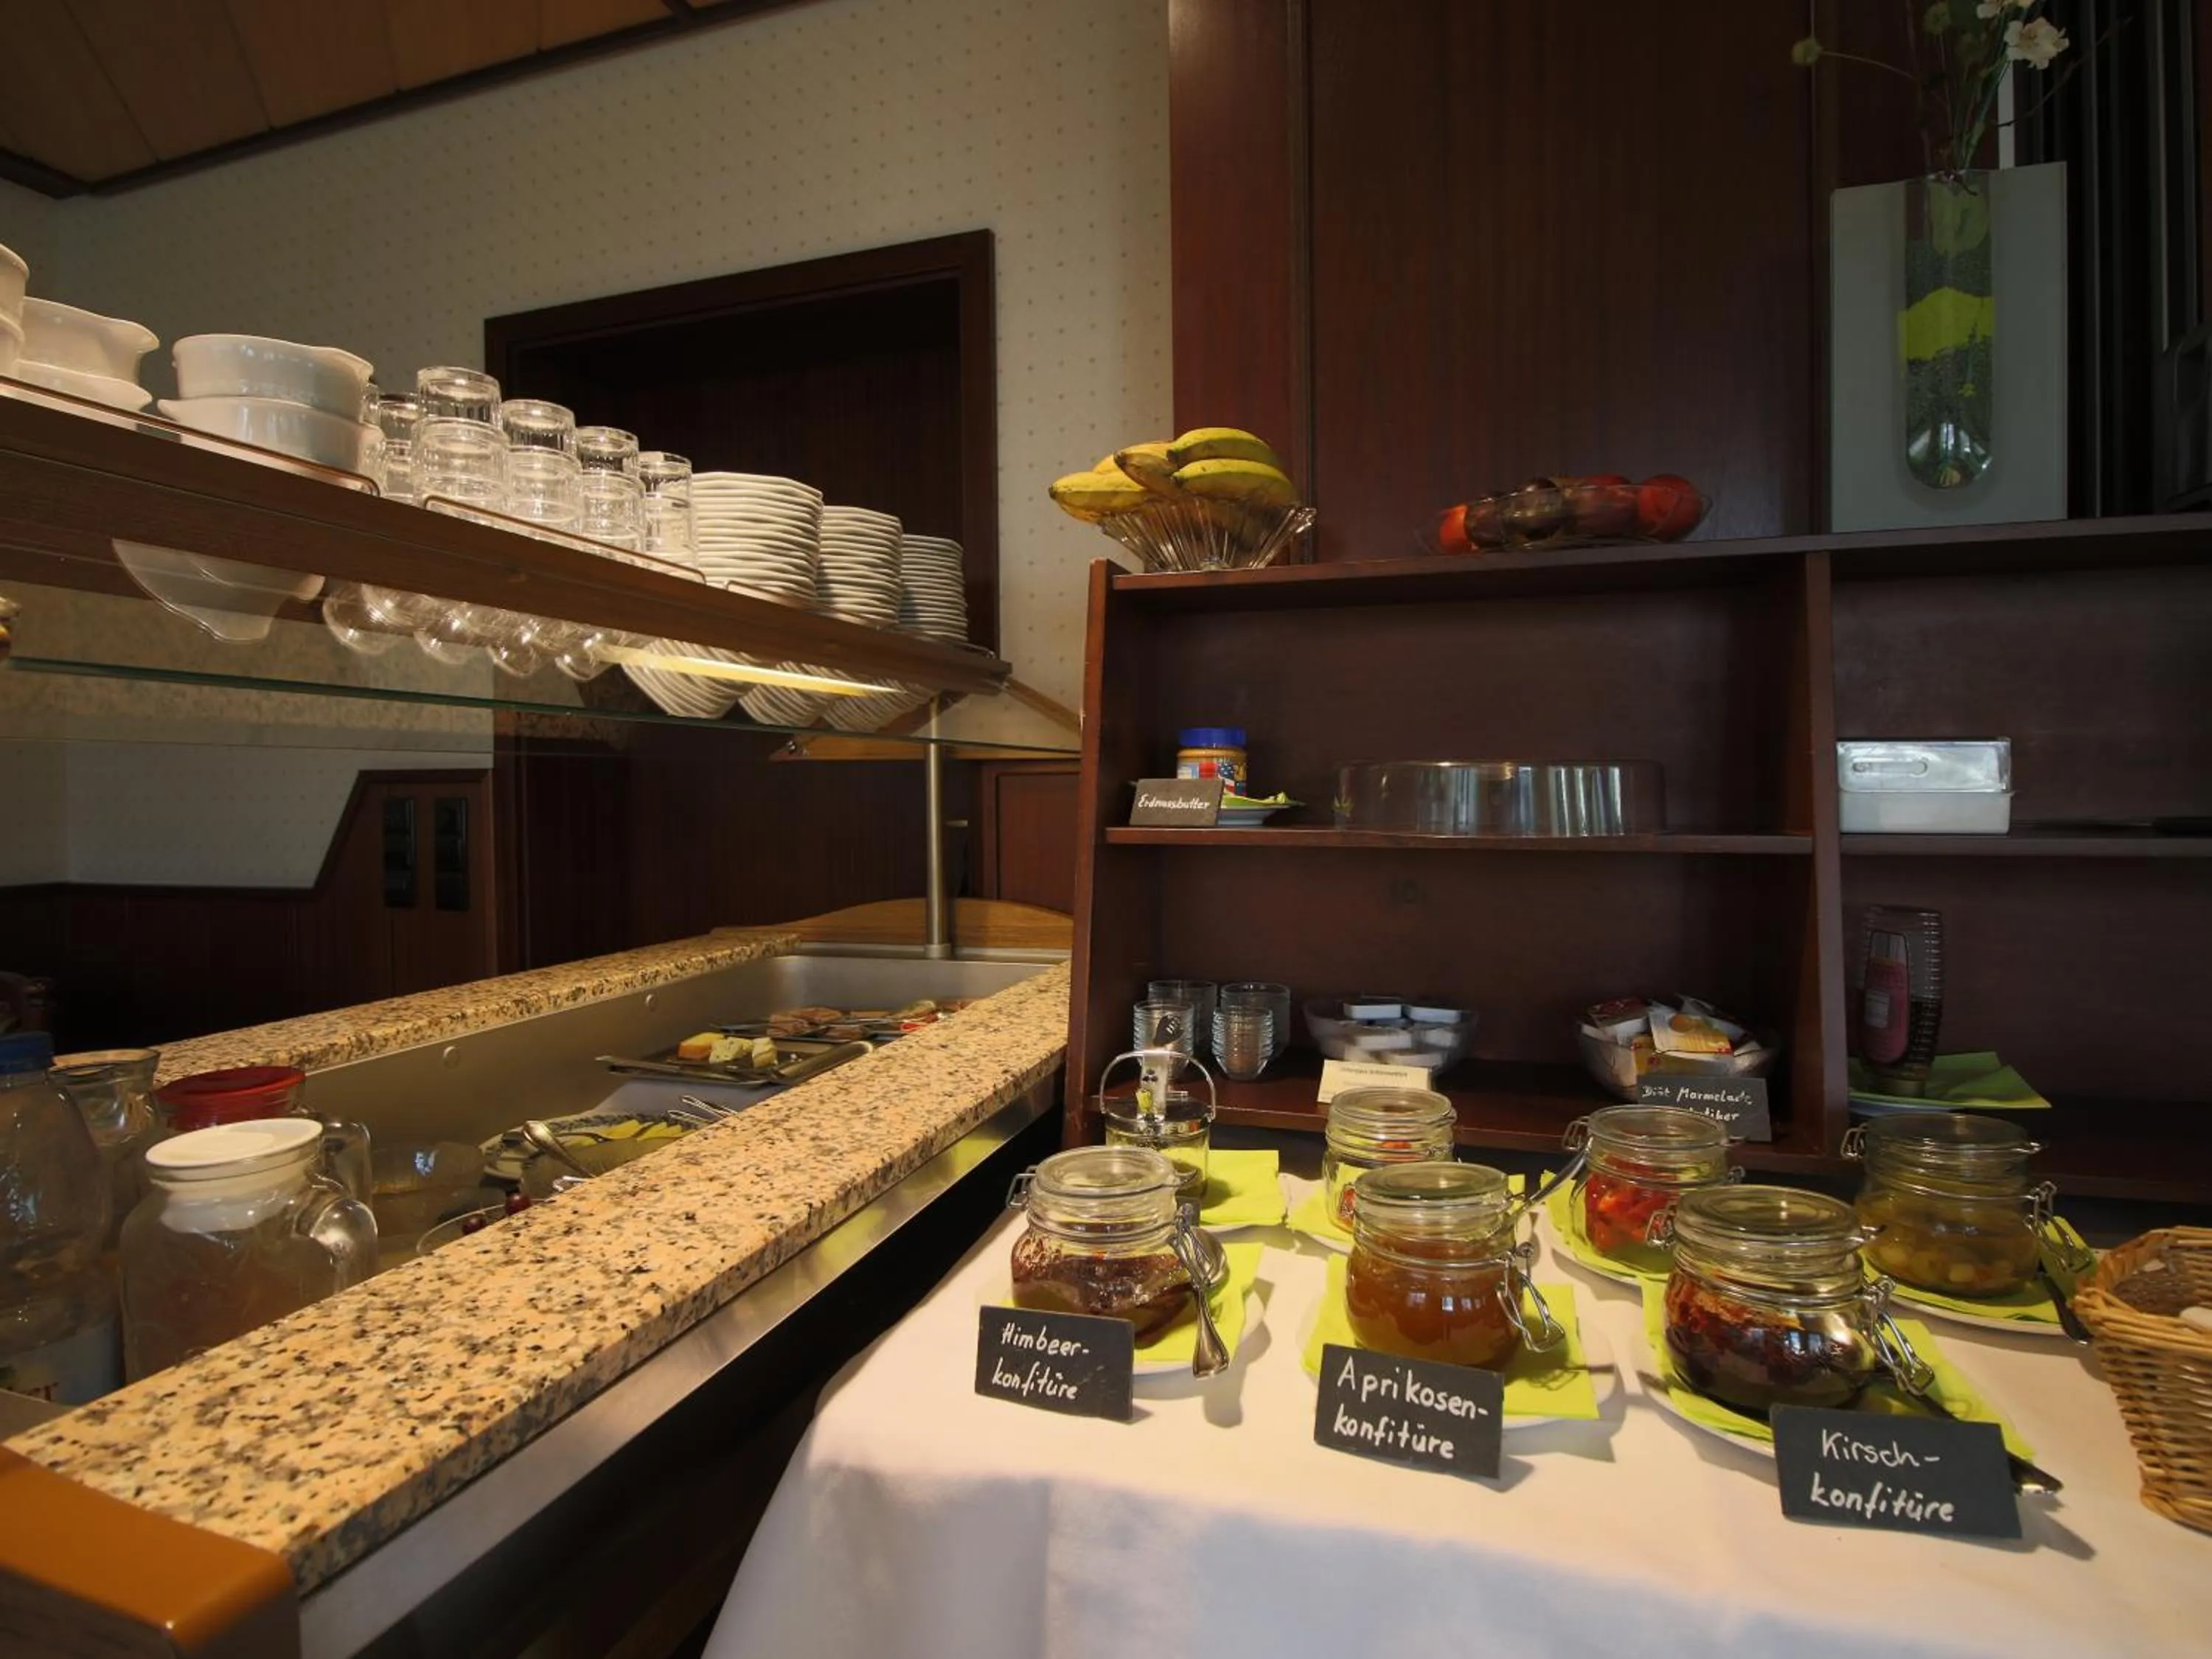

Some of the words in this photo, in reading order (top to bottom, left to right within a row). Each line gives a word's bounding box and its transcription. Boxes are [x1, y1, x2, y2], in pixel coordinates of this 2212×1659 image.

[1001, 1322, 1090, 1357] Himbeer-
[992, 1357, 1078, 1400] konfitüre
[1337, 1356, 1489, 1420] Aprikosen-
[1333, 1402, 1455, 1459] konfitüre
[1822, 1428, 1941, 1467] Kirsch-
[1810, 1472, 1955, 1523] konfitüre
